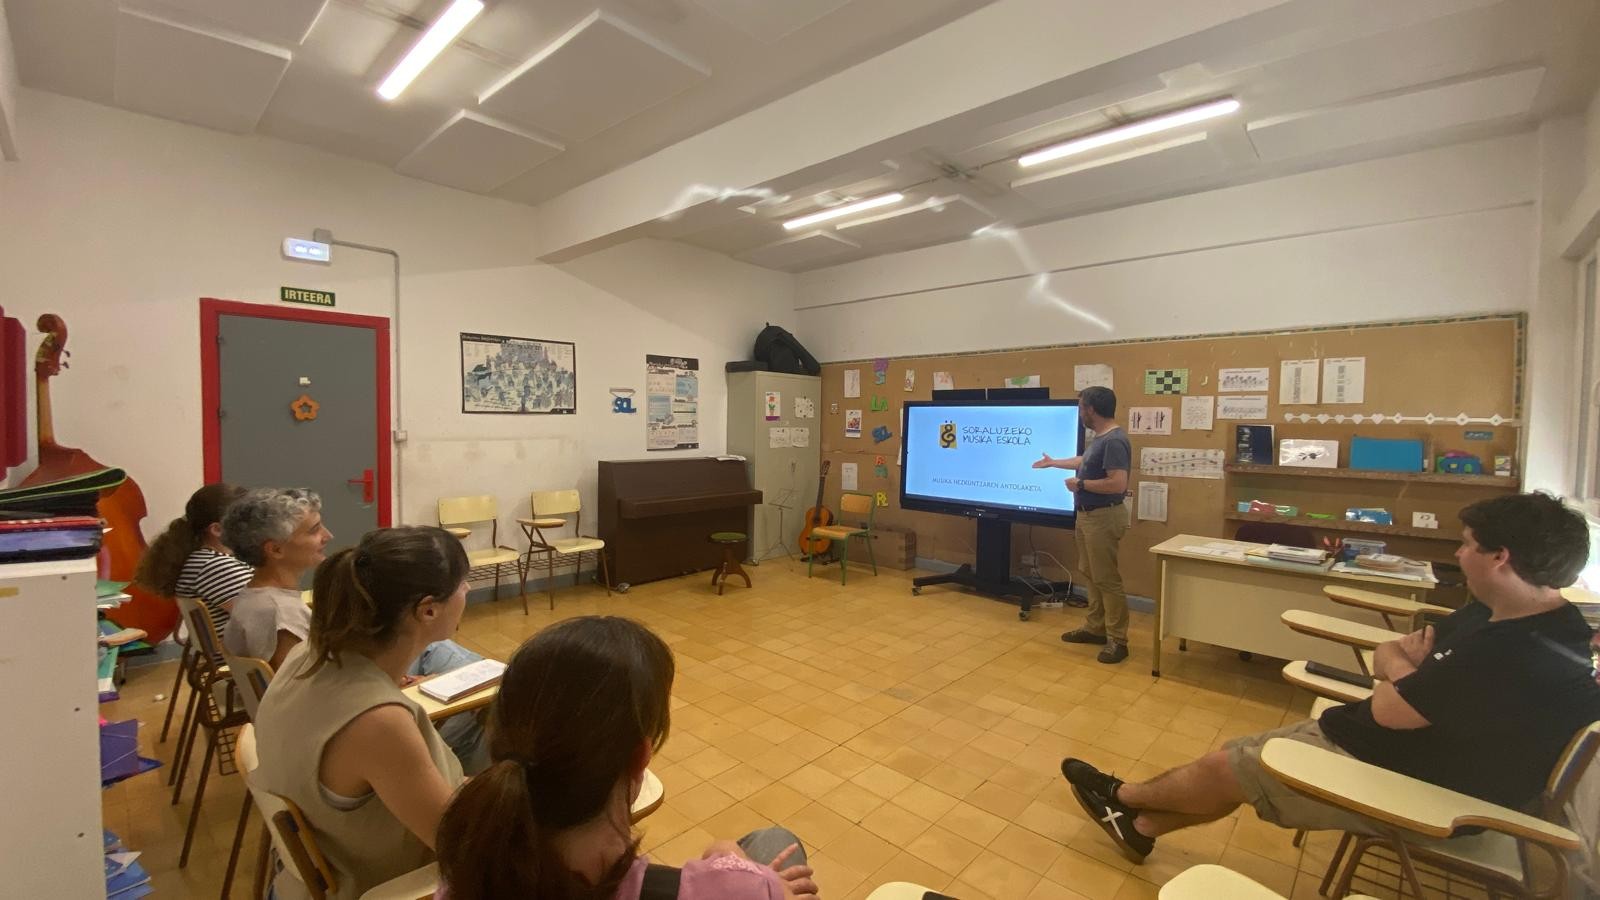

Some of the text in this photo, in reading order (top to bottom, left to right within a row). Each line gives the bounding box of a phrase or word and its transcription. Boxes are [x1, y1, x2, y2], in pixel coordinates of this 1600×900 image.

[285, 290, 332, 305] IRTEERA
[962, 426, 1033, 436] SORALUZEKO
[962, 435, 1032, 446] MUSIKA ESKOLA
